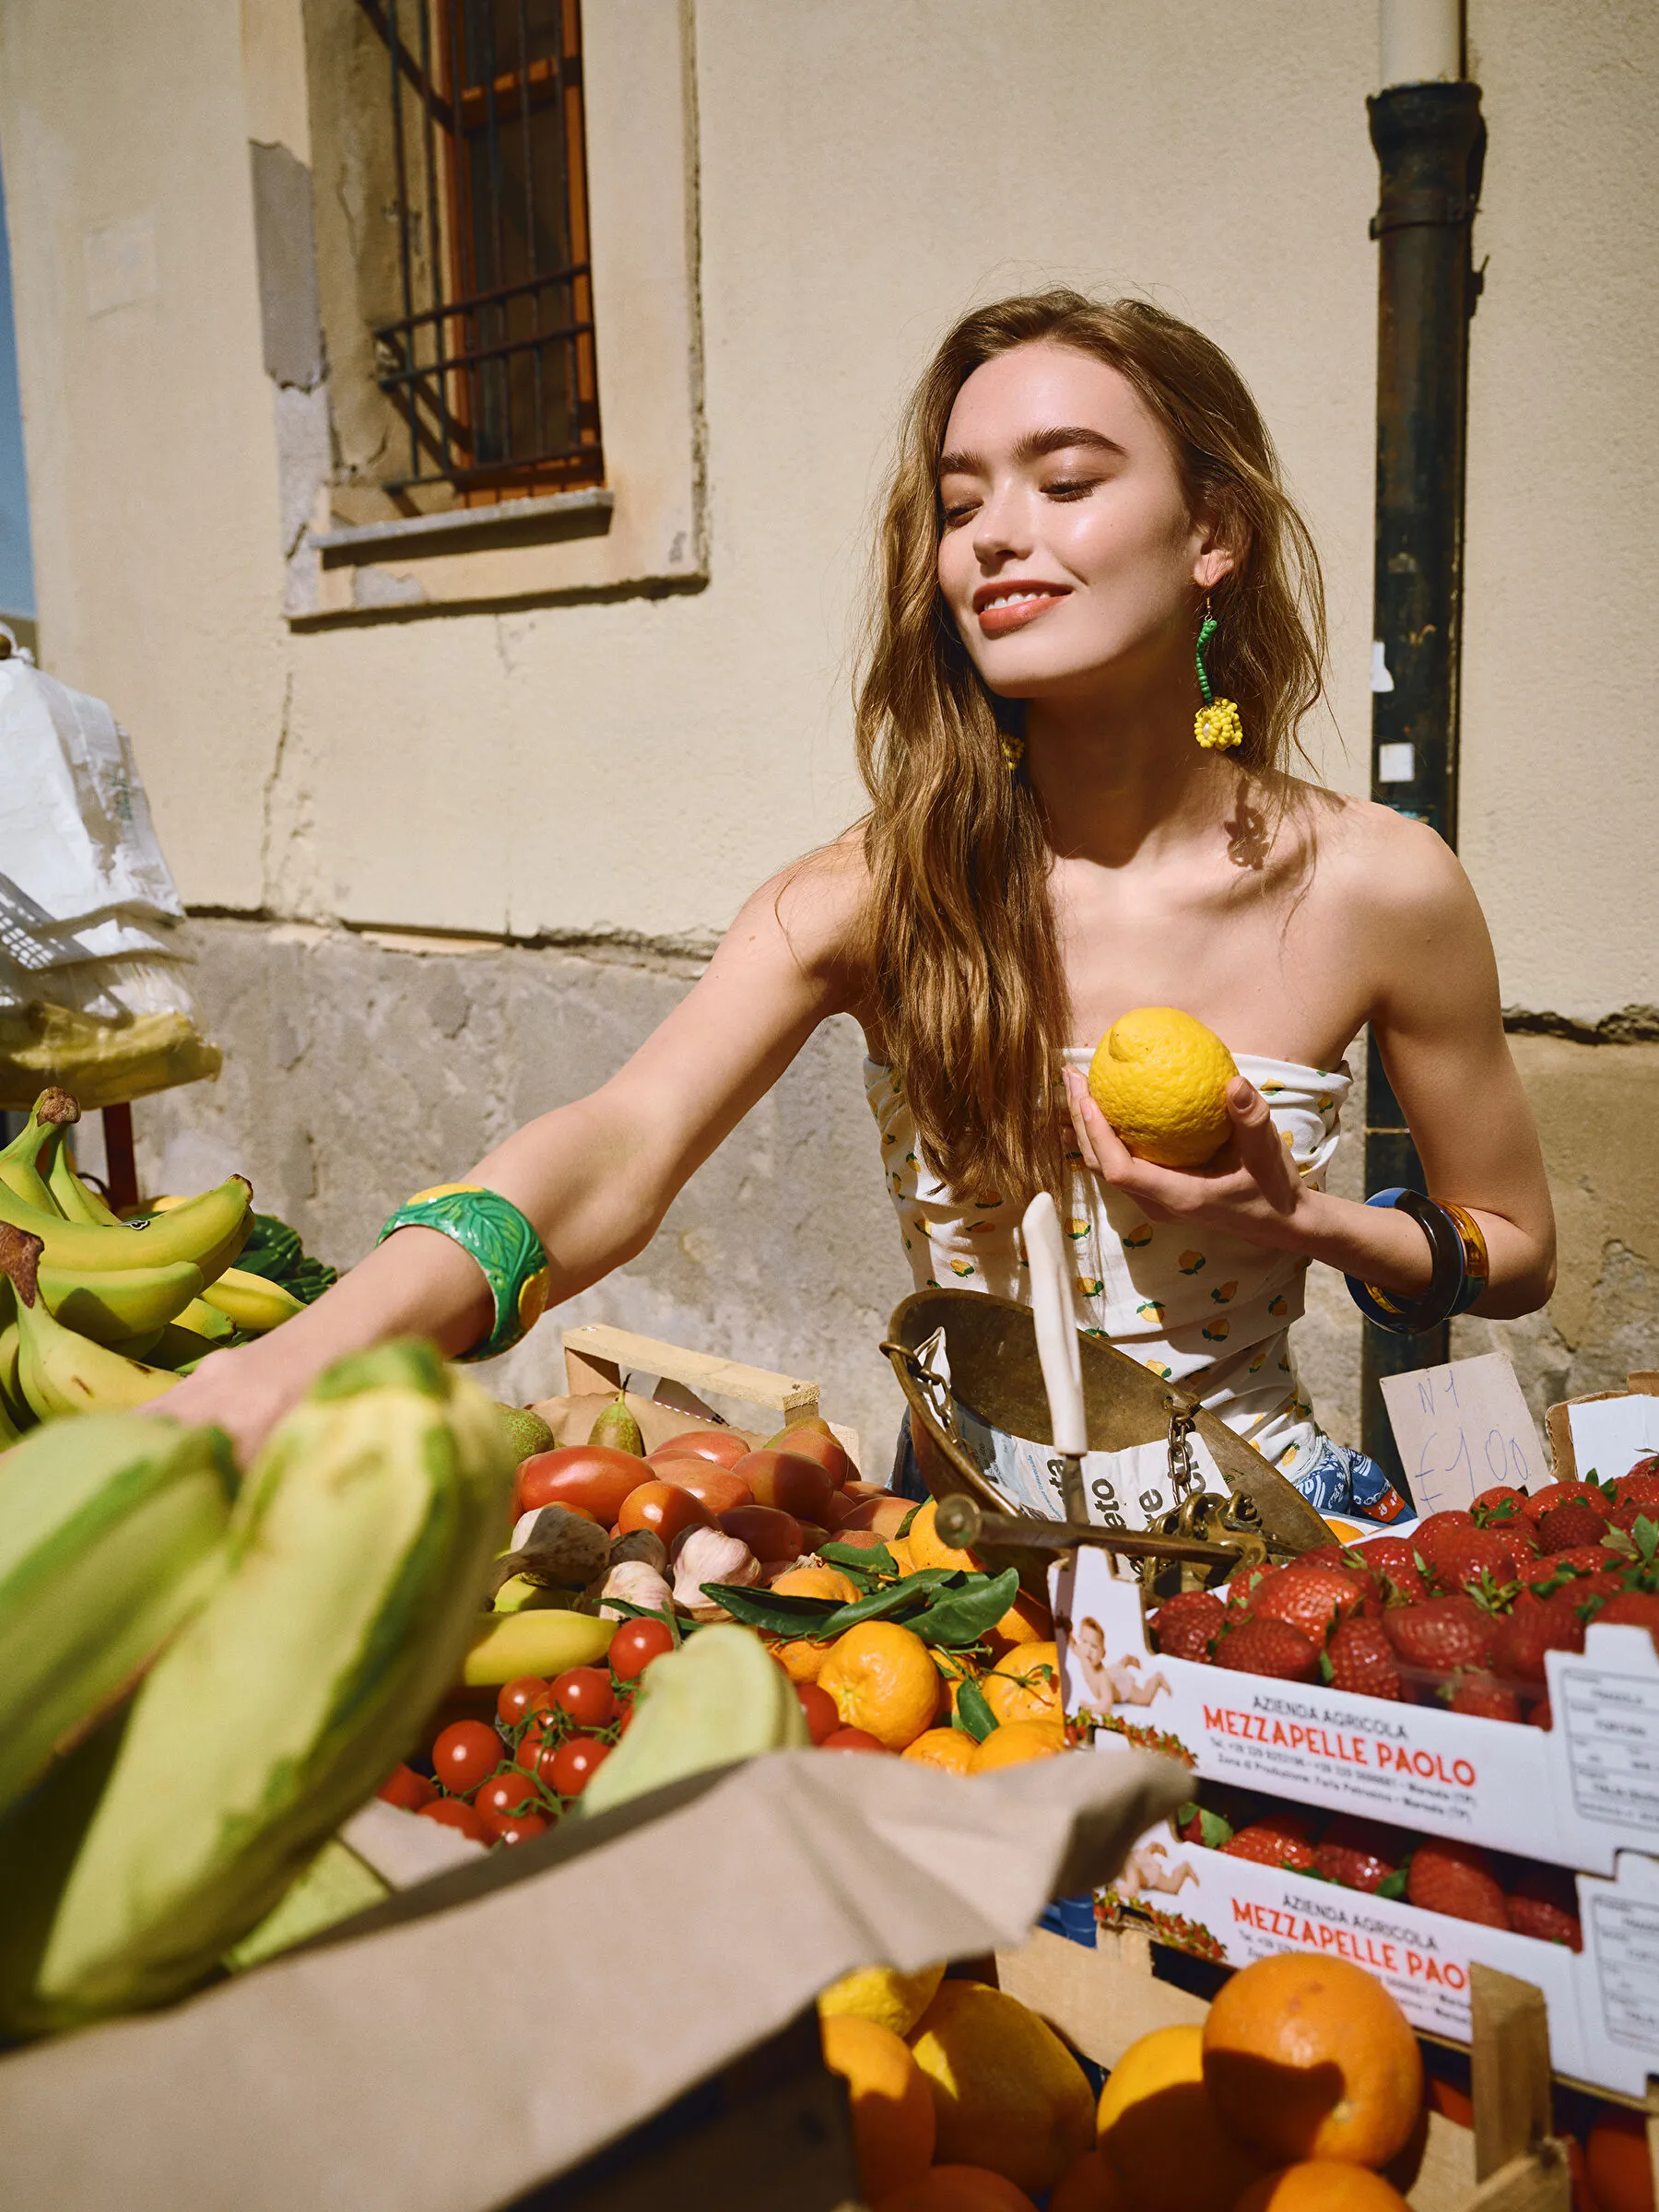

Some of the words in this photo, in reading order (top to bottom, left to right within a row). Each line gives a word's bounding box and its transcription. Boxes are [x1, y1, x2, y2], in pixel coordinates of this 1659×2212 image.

[1091, 1478, 1127, 1530] eto
[1203, 1704, 1369, 1765] MEZZAPELLE
[1377, 1742, 1477, 1787] PAOLO
[1253, 1695, 1317, 1721] AZIENDA
[1323, 1708, 1409, 1740] AGRICOLA
[1230, 1897, 1398, 1971] MEZZAPELLE
[1406, 1950, 1466, 1990] PAO
[1282, 1892, 1348, 1924] AZIENDA
[1352, 1914, 1439, 1952] AGRICOLA
